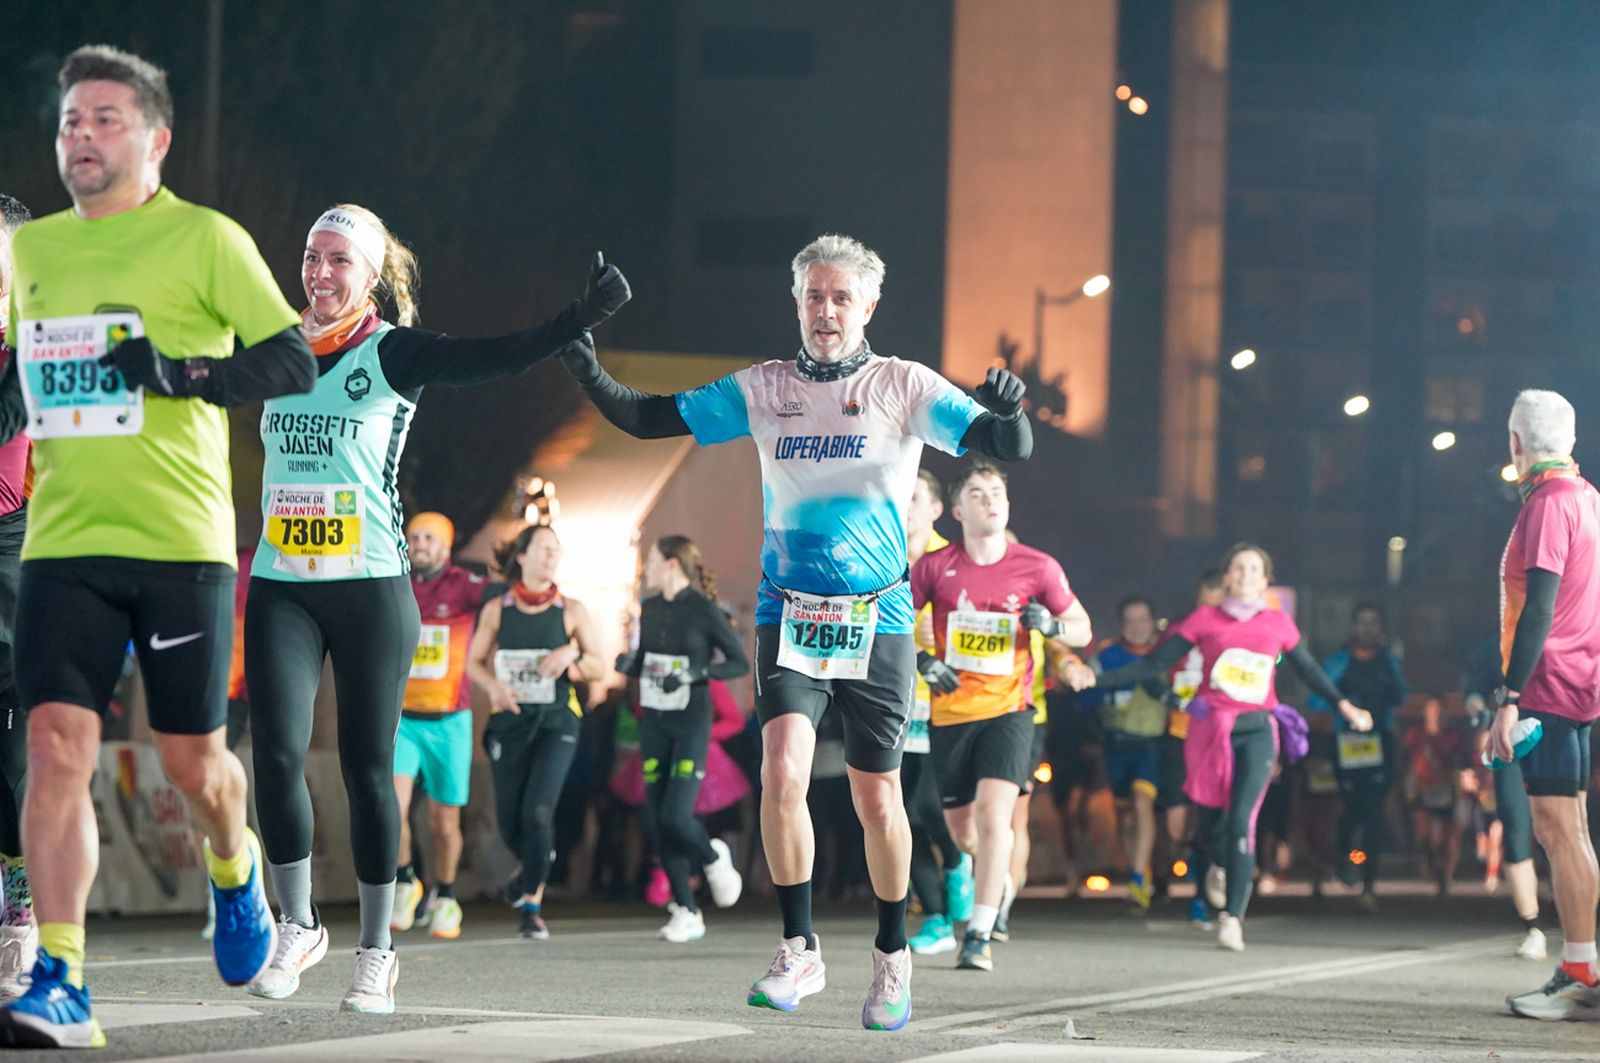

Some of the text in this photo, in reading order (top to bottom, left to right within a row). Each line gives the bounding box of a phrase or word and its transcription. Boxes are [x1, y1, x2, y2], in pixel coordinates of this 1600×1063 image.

[279, 434, 334, 457] JAEN
[775, 435, 868, 463] LOPERABIKE
[288, 460, 320, 473] RUNNING
[285, 494, 326, 505] NOCHE DE
[274, 506, 291, 516] SAN
[281, 518, 344, 546] 7303
[794, 610, 811, 621] SAN
[802, 603, 830, 612] NOCHE
[793, 622, 864, 650] 12645
[959, 632, 1005, 652] 12261
